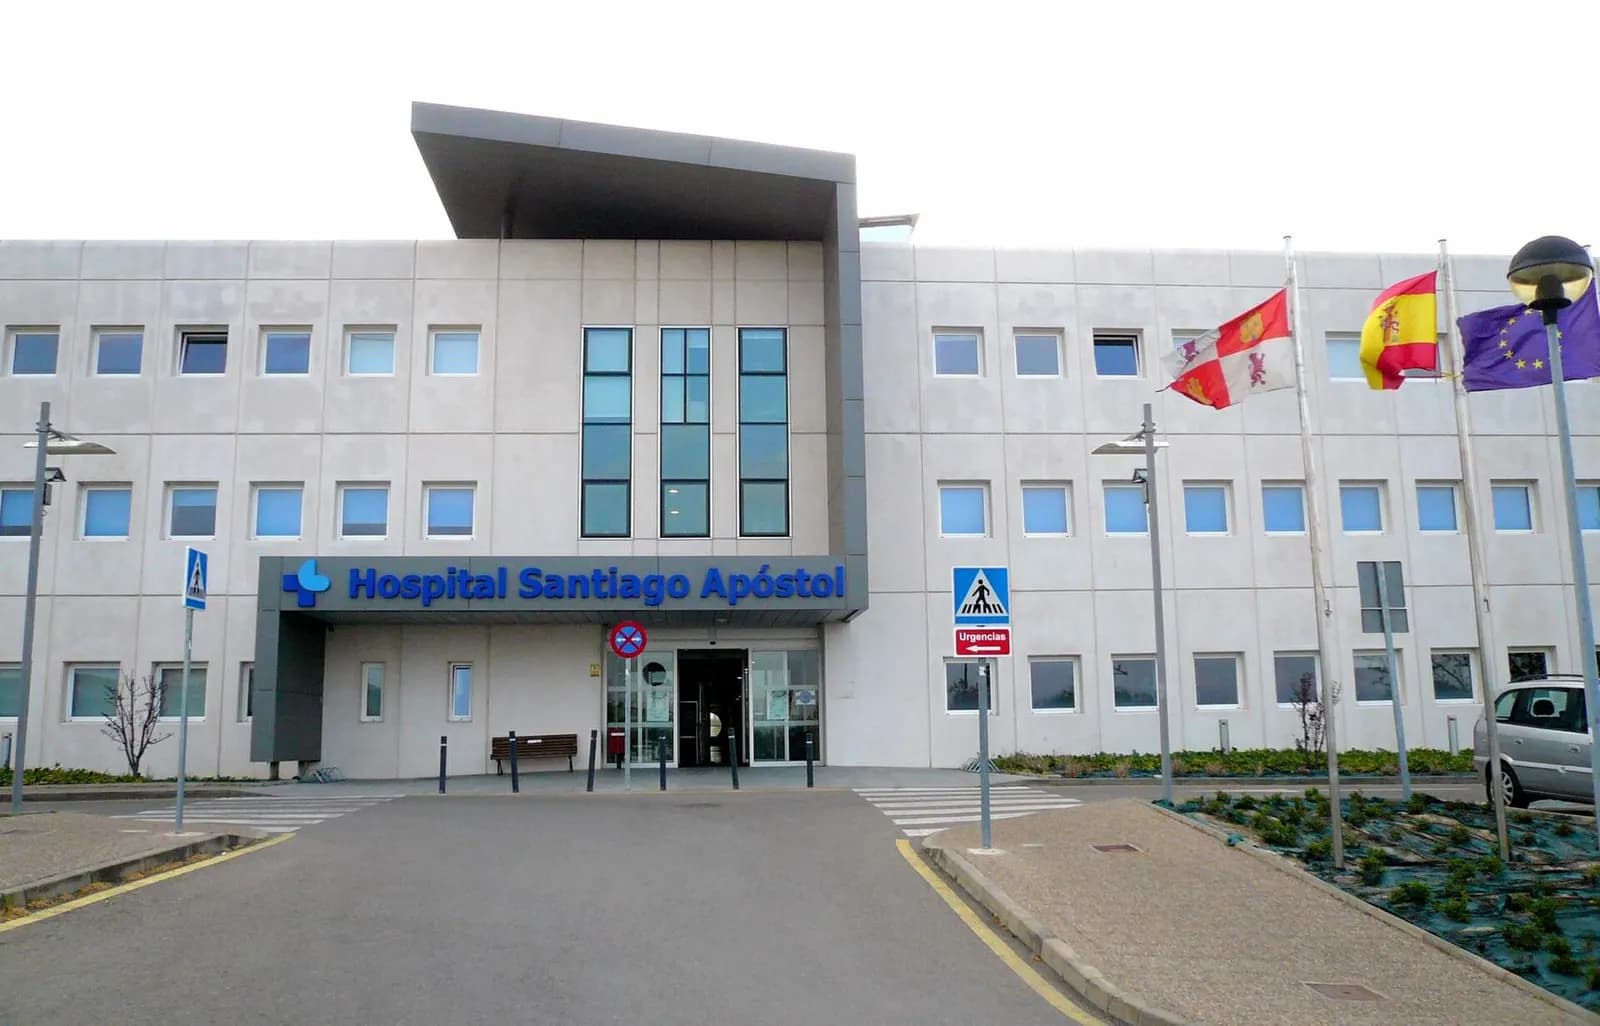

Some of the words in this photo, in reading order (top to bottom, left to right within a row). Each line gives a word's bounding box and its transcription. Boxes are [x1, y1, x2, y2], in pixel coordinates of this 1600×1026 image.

[349, 567, 507, 607] Hospital
[518, 566, 691, 607] Santiago
[700, 564, 845, 606] Apóstol
[959, 632, 1006, 643] Urgencias
